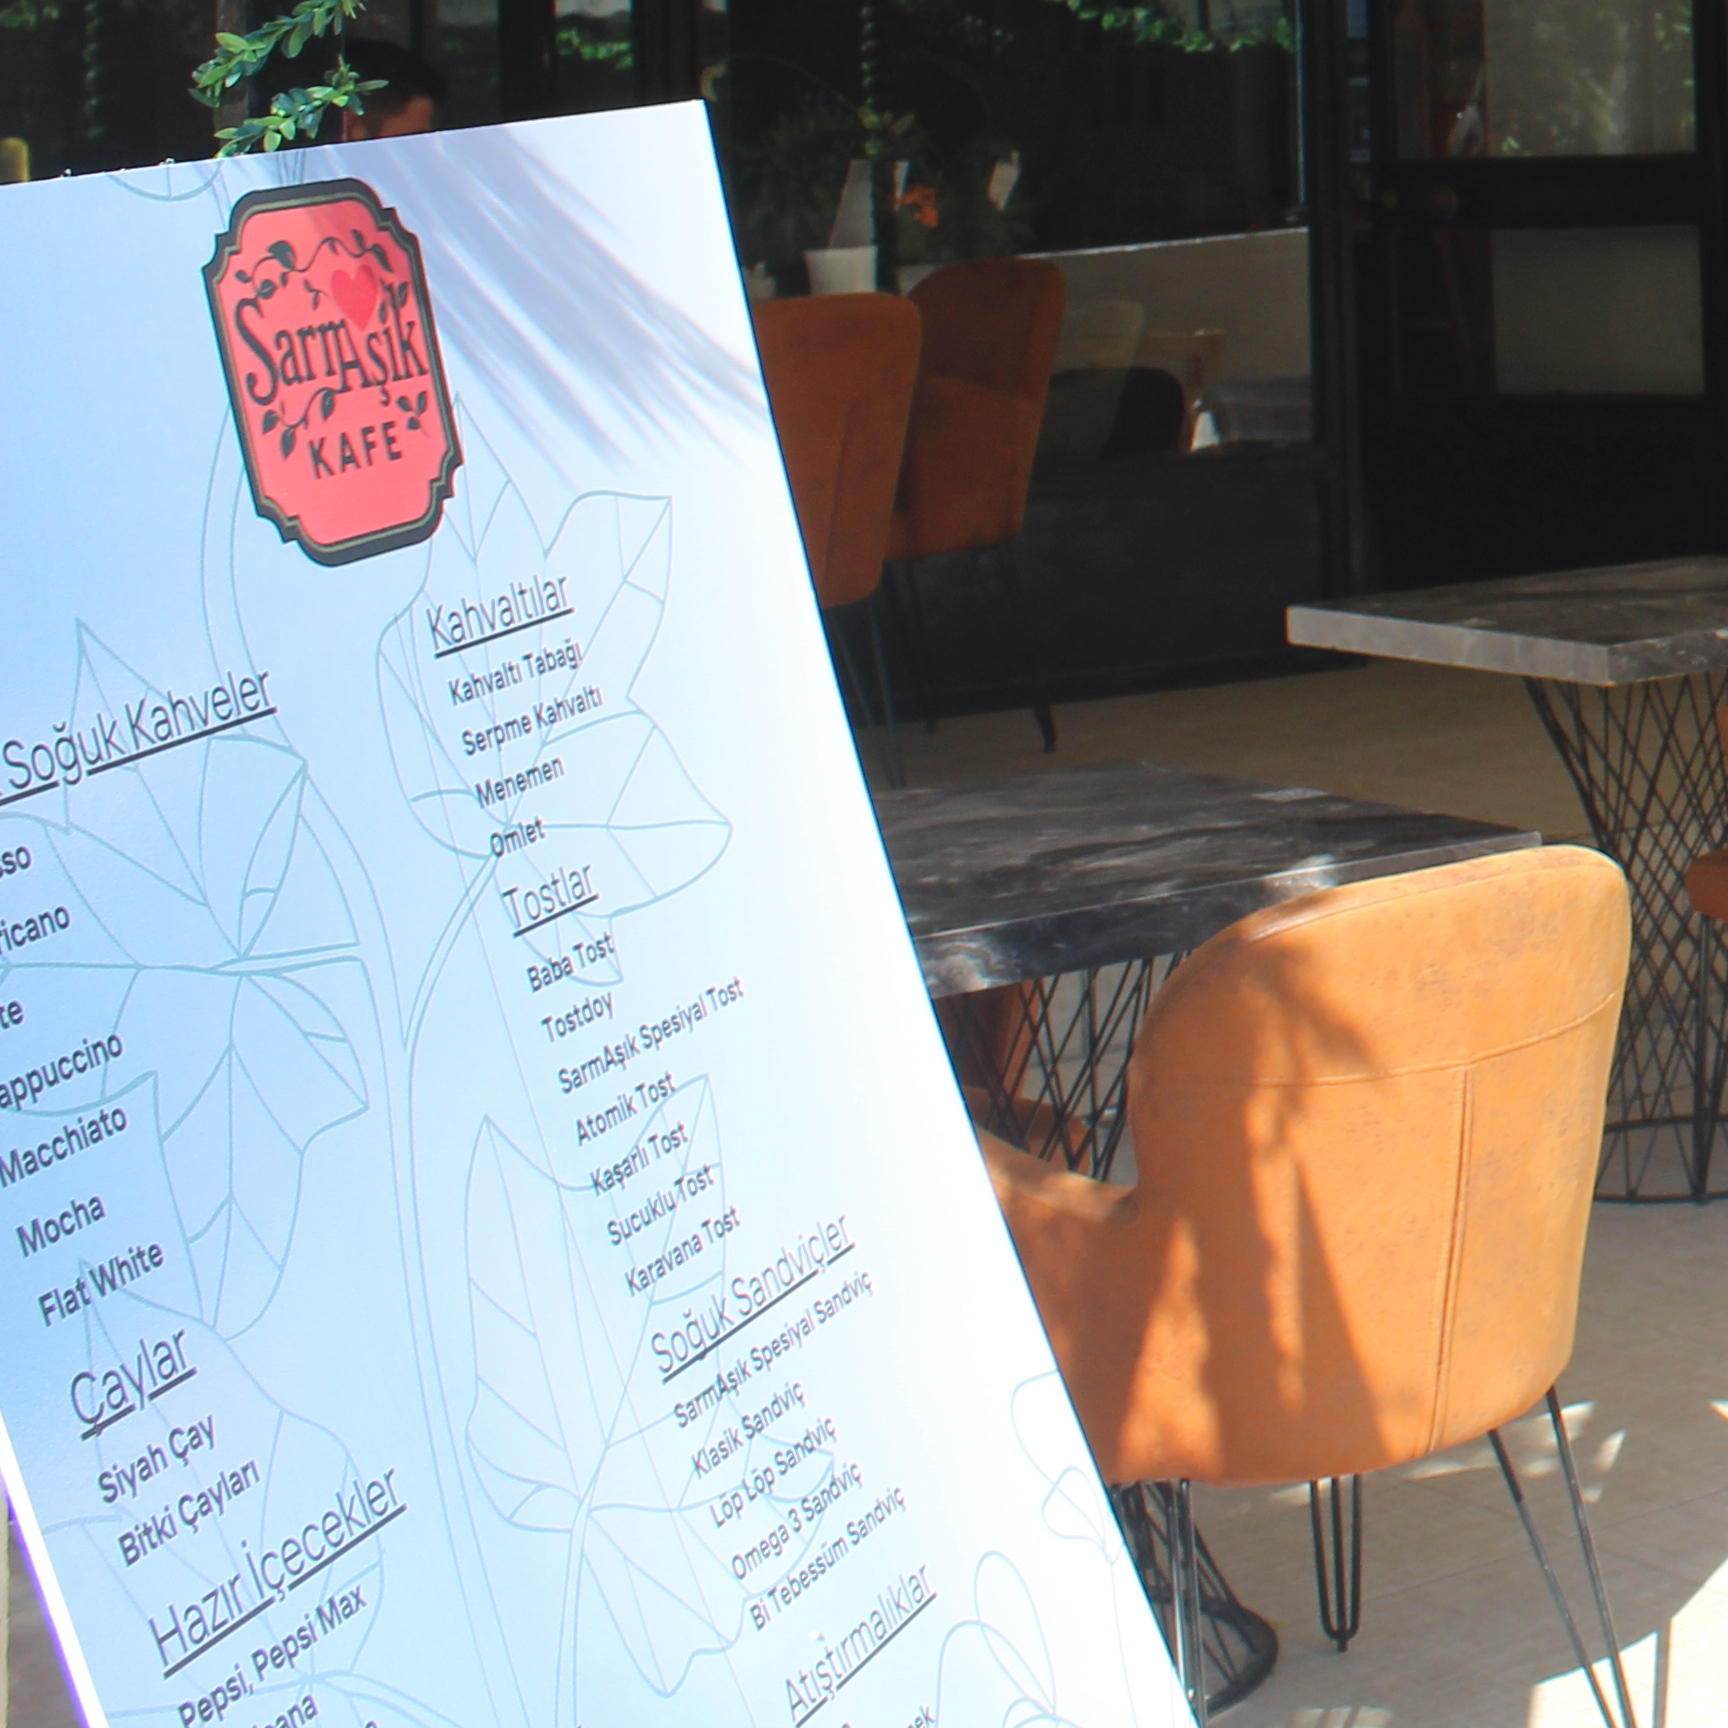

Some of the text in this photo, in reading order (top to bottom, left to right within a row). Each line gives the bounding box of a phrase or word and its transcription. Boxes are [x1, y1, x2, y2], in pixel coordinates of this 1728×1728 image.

[308, 420, 403, 479] KAFE
[426, 574, 569, 653] Kahvaltılar
[448, 637, 583, 707] Kahvaltı Tabağı
[3, 671, 270, 786] Soğuk Kahveler
[461, 684, 604, 757] Serpme Kahvaltı
[474, 757, 565, 809] Menemen
[488, 815, 547, 859] Omlet
[500, 864, 593, 929] Tostlar
[526, 931, 616, 994] Baba Tost
[540, 991, 615, 1044] Tostdoy
[557, 976, 745, 1095] SarmAşık Spesiyal Tost
[0, 1034, 123, 1111] appuccino
[575, 1071, 677, 1147] Atomik Tost
[0, 1108, 127, 1188] Macchiato
[589, 1121, 689, 1197] Kaşarlı Tost
[16, 1195, 106, 1258] Mocha
[606, 1164, 715, 1247] Sucuklu Tost
[37, 1243, 165, 1327] Flat White
[623, 1205, 741, 1298] Karavana Tost
[651, 1215, 849, 1376] Soğuk Sandviçler
[69, 1329, 188, 1438] Çaylar
[673, 1270, 874, 1430] SarmAşık Spesiyal Sandviç
[97, 1413, 216, 1504] Siyah Çay
[691, 1380, 806, 1480] Klasik Sandviç
[708, 1415, 838, 1529] Löp Löp Sandviç
[117, 1459, 262, 1568] Bitki Çayları
[731, 1462, 864, 1581] Omega 3 Sandviç
[148, 1467, 398, 1669] Hazır İçecekler
[749, 1486, 907, 1632] Bi Tebessüm Sandviç
[250, 1612, 320, 1683] Pepsi
[315, 1584, 369, 1635] Max
[785, 1563, 930, 1723] Atıştırmalıklar
